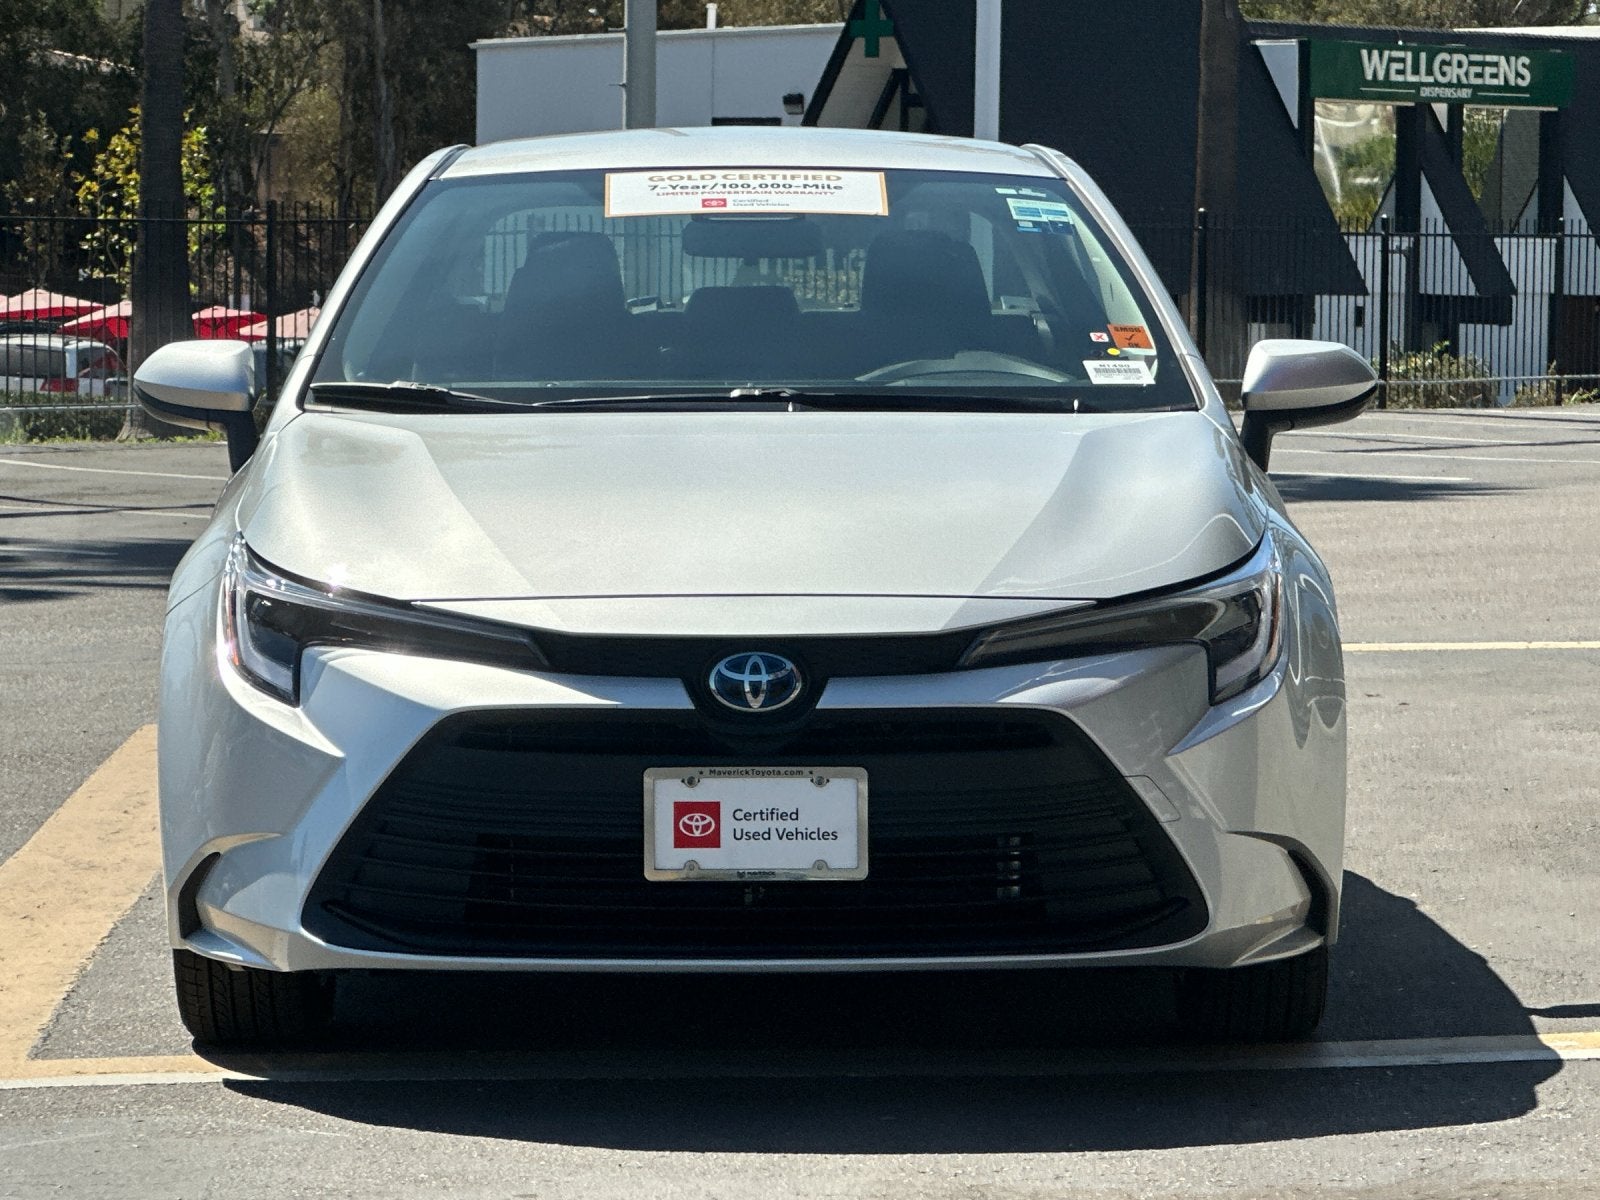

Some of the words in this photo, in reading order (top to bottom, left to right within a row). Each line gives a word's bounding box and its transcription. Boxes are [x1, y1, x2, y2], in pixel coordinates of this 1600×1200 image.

[1360, 49, 1531, 87] WELLGREENS
[1419, 86, 1473, 98] DISPENSARY
[648, 173, 717, 182] GOLD
[721, 173, 843, 182] CERTIFIED
[648, 182, 843, 191] 7-Year/100,000-Mile
[708, 768, 804, 777] MaverickToyota.com
[732, 807, 799, 822] Certified
[732, 827, 772, 841] Used
[775, 827, 839, 841] Vehicles
